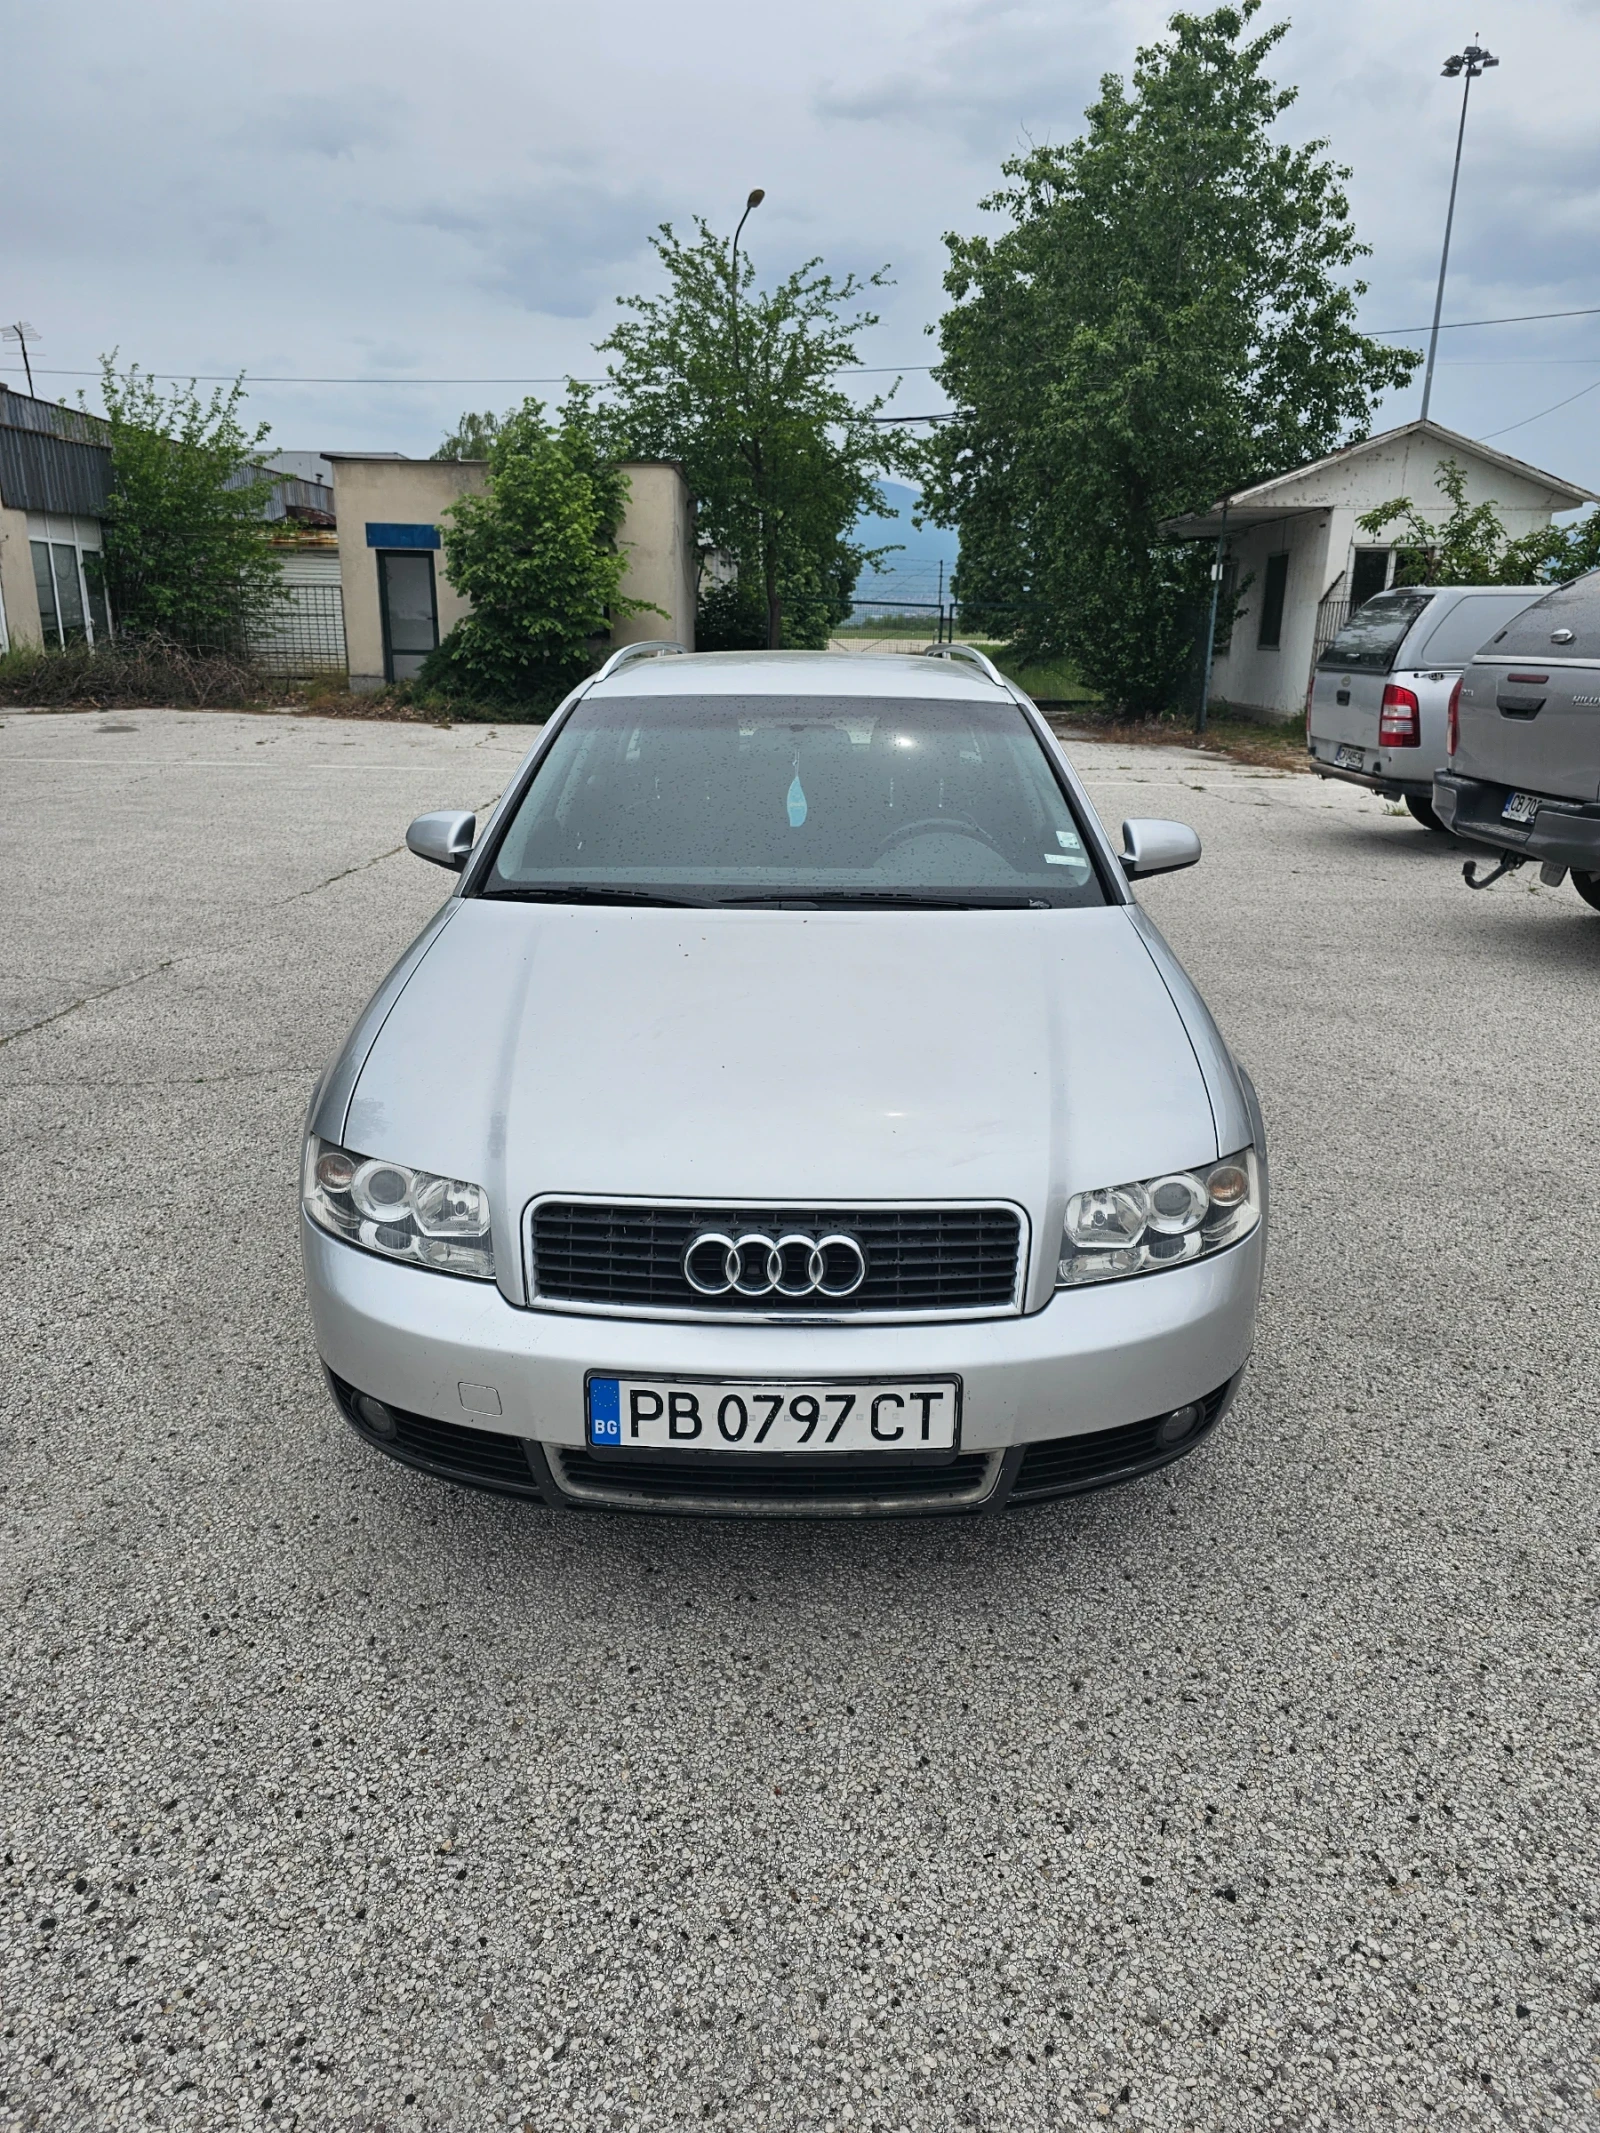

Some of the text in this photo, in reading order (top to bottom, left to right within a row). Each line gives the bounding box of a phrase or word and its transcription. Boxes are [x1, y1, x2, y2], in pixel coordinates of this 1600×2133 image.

[1510, 794, 1526, 813] CB
[629, 1389, 944, 1443] PB 0797 CT
[595, 1419, 617, 1435] BG
